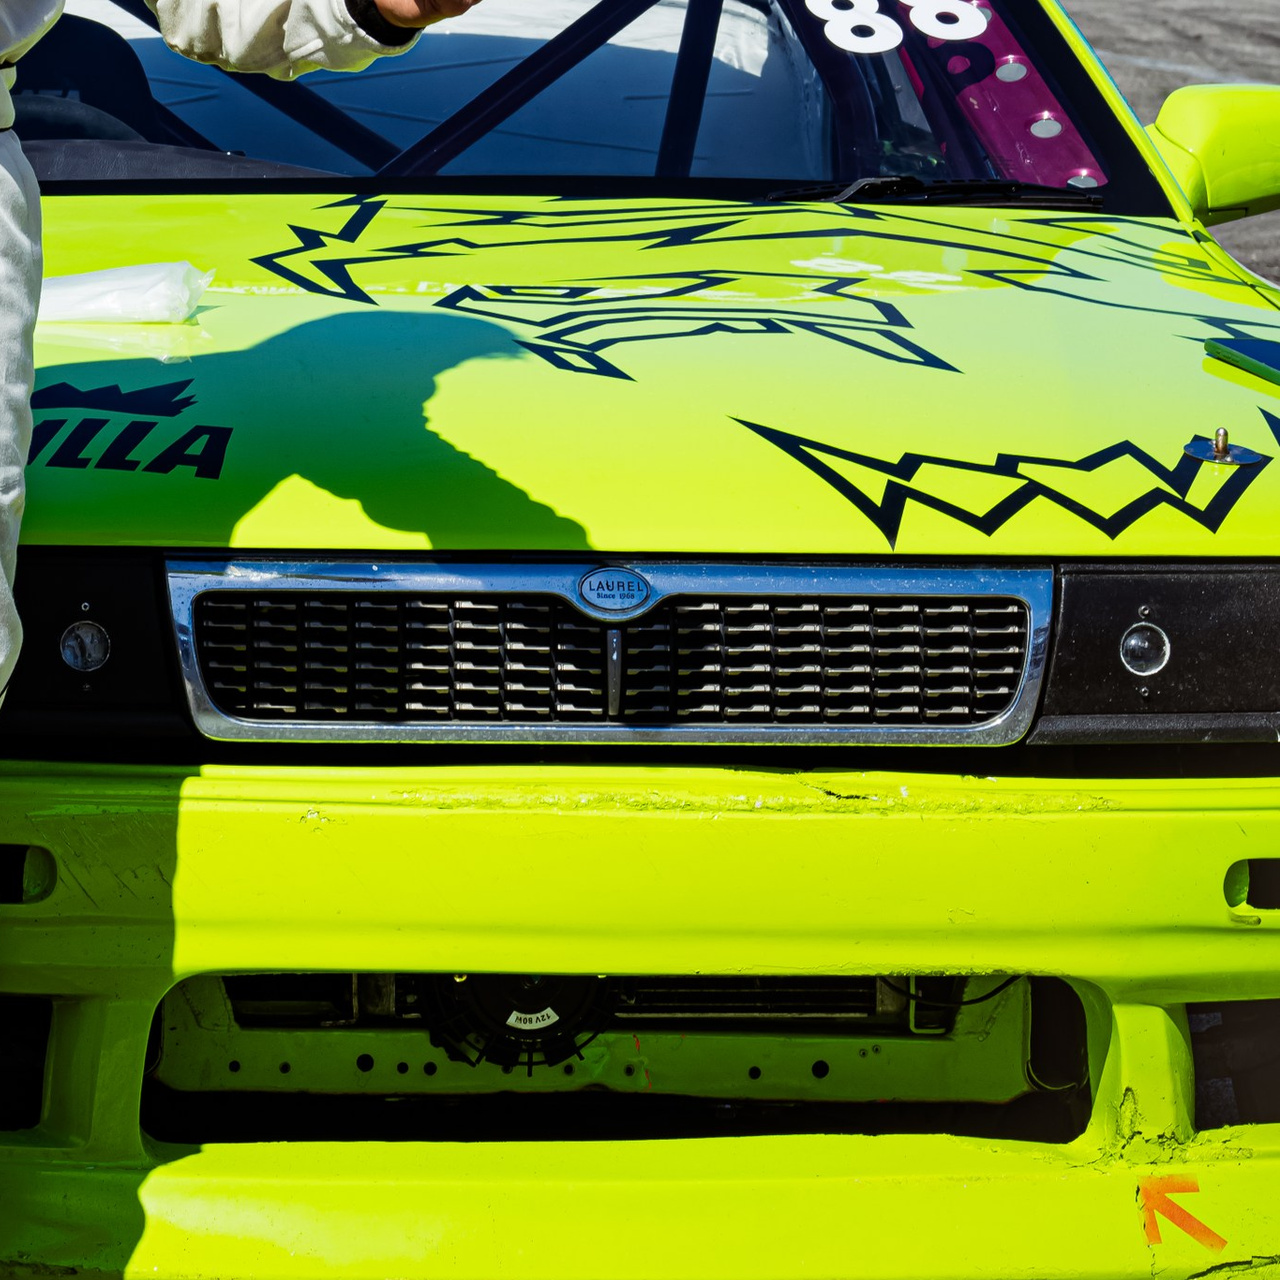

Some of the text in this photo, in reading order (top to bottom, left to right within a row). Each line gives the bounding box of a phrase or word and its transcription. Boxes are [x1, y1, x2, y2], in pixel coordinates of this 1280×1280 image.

[588, 580, 644, 592] LAUREL
[596, 592, 635, 600] Since 1968
[514, 1012, 552, 1025] 12V 80W
